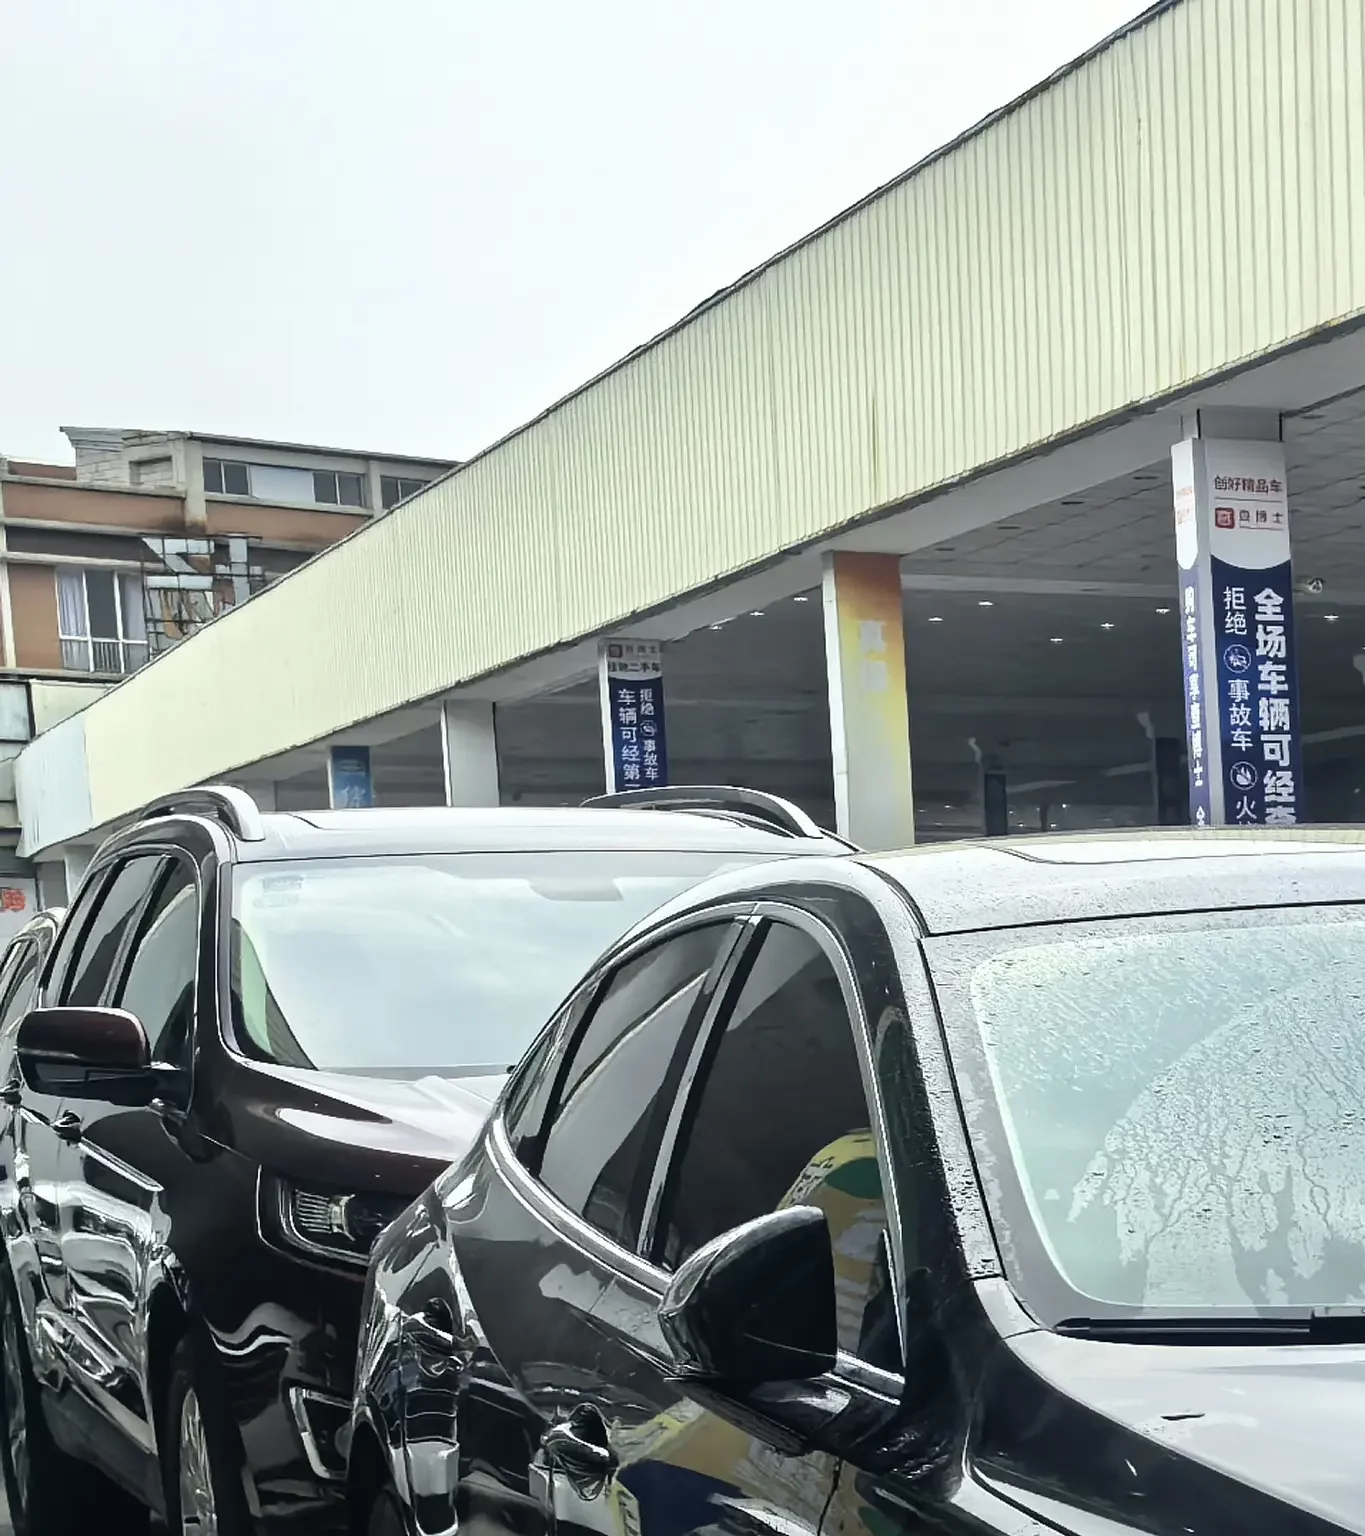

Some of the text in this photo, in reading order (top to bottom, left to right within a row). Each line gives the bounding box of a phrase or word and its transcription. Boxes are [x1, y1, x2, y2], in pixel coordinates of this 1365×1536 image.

[1223, 586, 1248, 636] 拒绝
[1227, 677, 1254, 753] 事故车
